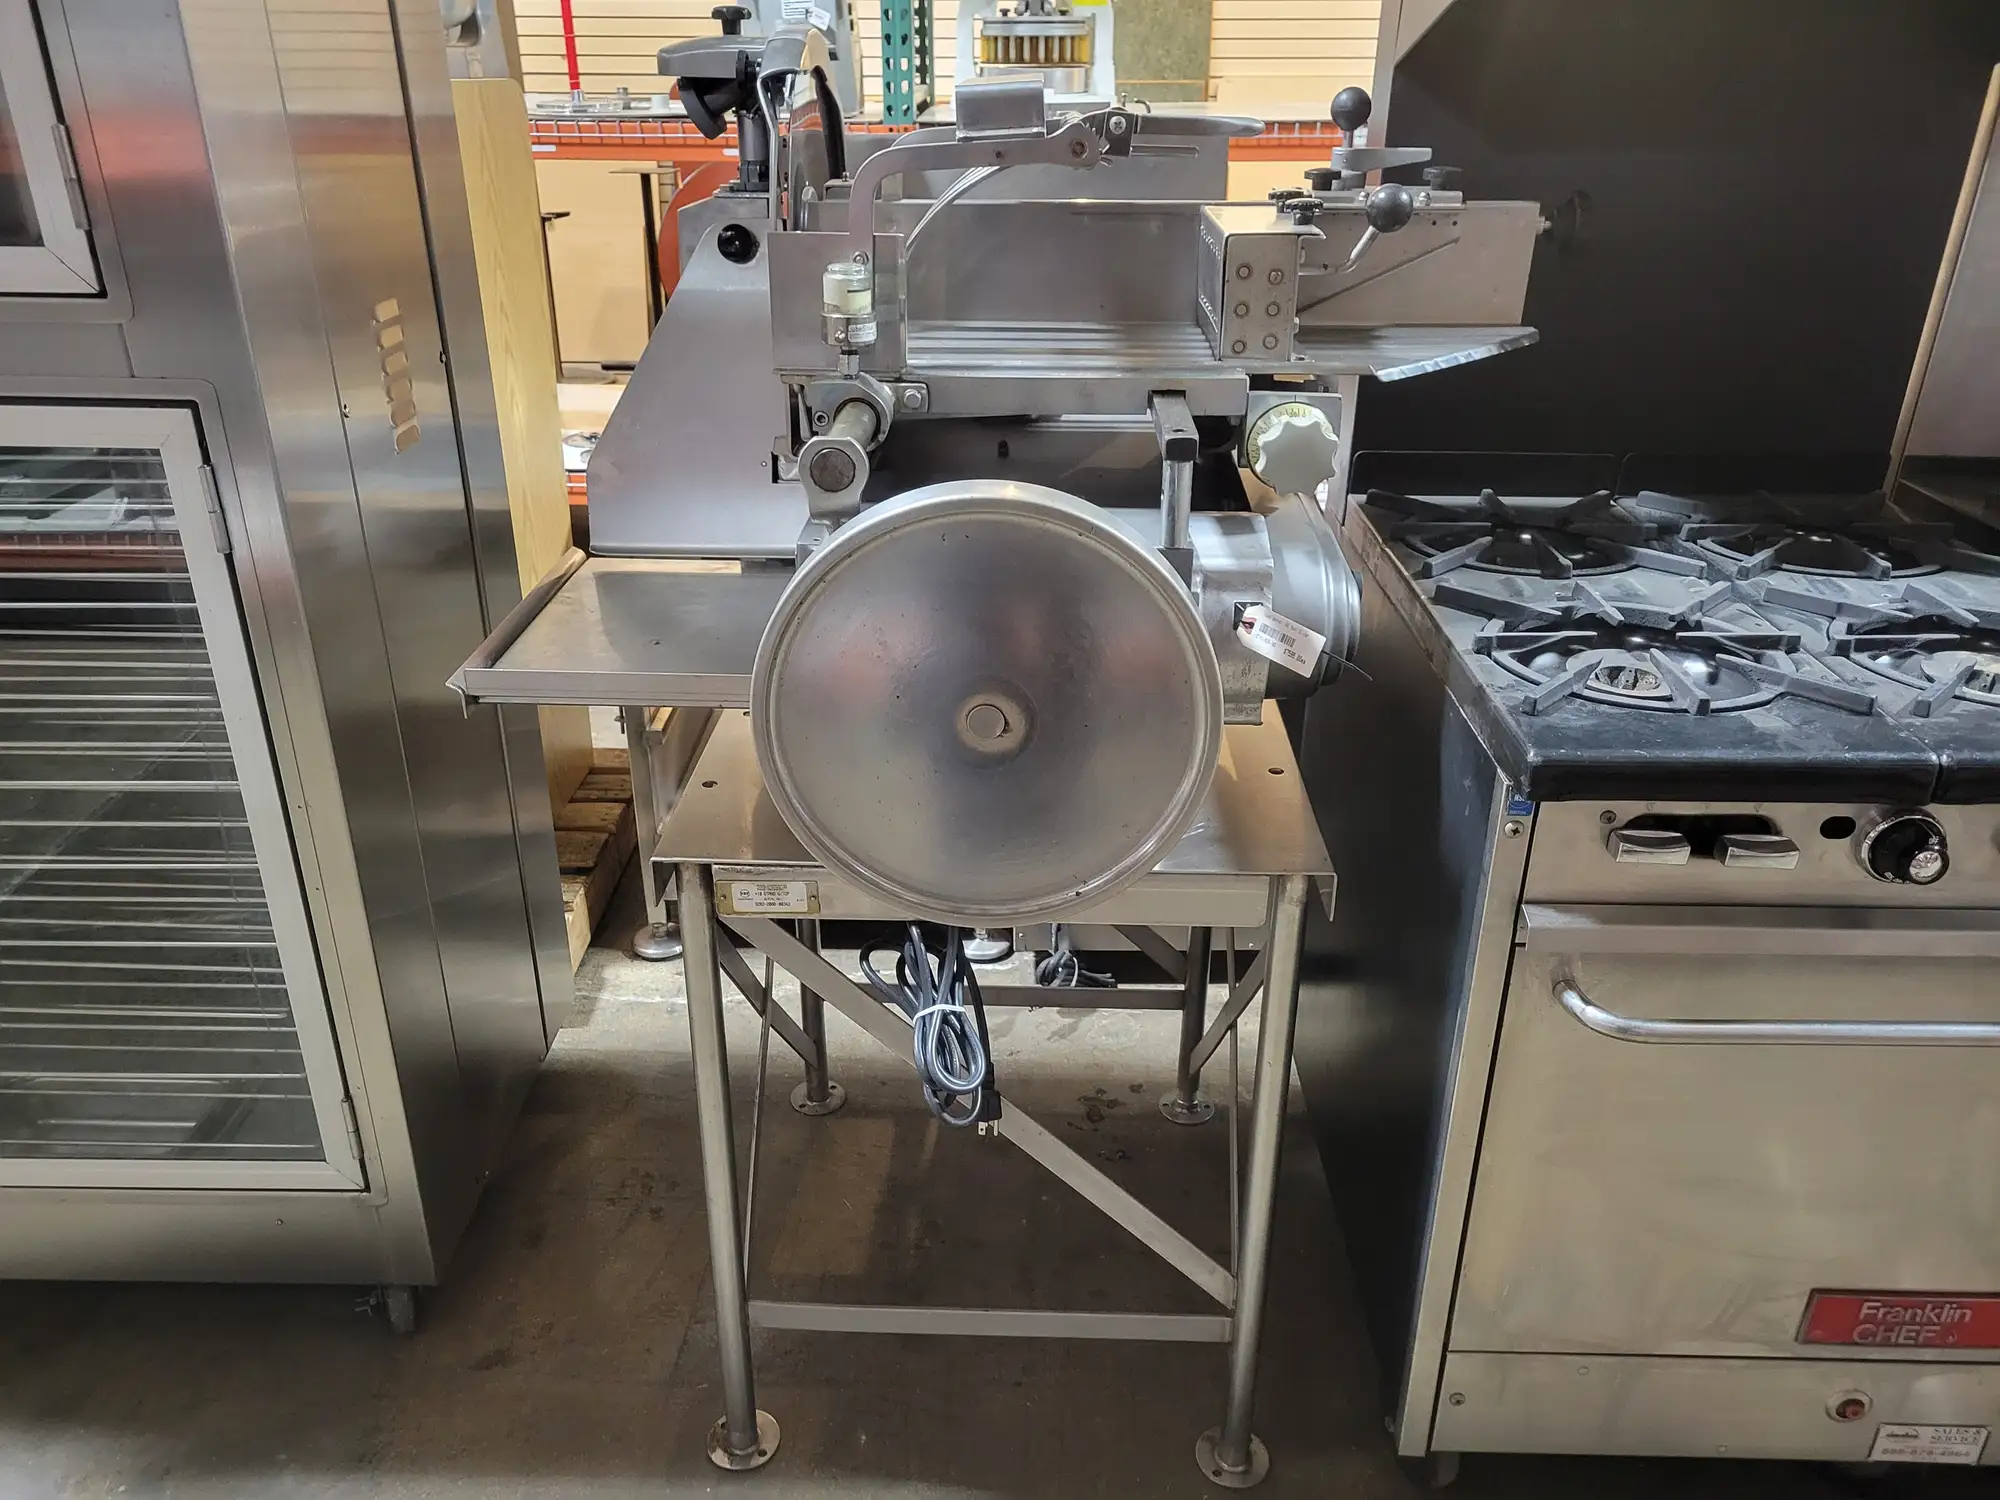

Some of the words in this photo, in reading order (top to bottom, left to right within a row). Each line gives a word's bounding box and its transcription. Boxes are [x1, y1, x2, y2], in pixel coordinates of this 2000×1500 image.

[1928, 836, 1940, 844] OFF
[1859, 1301, 1973, 1324] Franklin
[1852, 1324, 1942, 1344] CHEF
